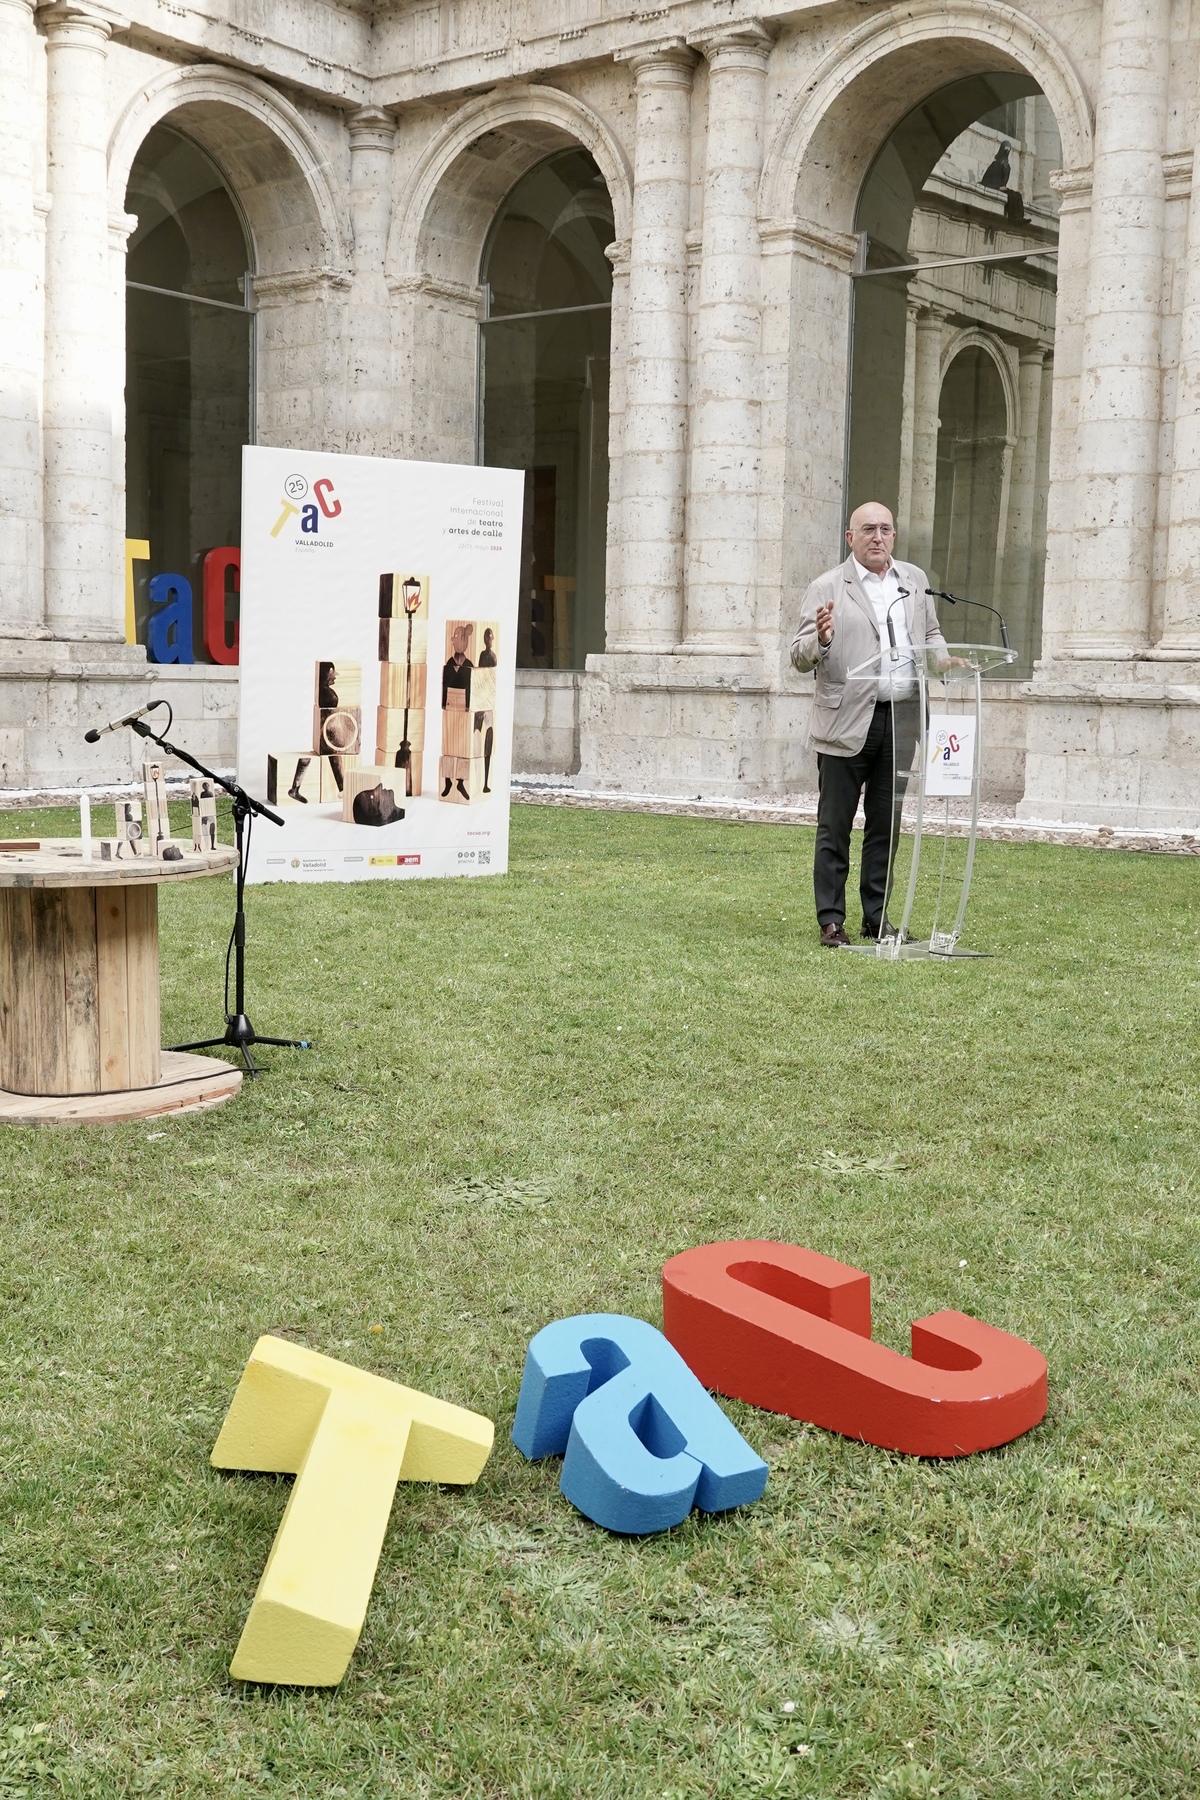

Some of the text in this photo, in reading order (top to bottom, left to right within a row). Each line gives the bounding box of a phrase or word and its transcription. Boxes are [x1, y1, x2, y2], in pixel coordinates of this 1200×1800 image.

[288, 479, 304, 494] 25
[472, 497, 503, 507] Festival
[269, 478, 342, 538] TaC
[450, 506, 503, 517] internacional
[467, 518, 503, 527] de teatro
[448, 527, 469, 535] artes
[471, 528, 481, 536] de
[482, 529, 503, 538] calle
[295, 539, 334, 548] VALLADOLID
[931, 734, 960, 764] TaC
[209, 1240, 1048, 1687] TaC
